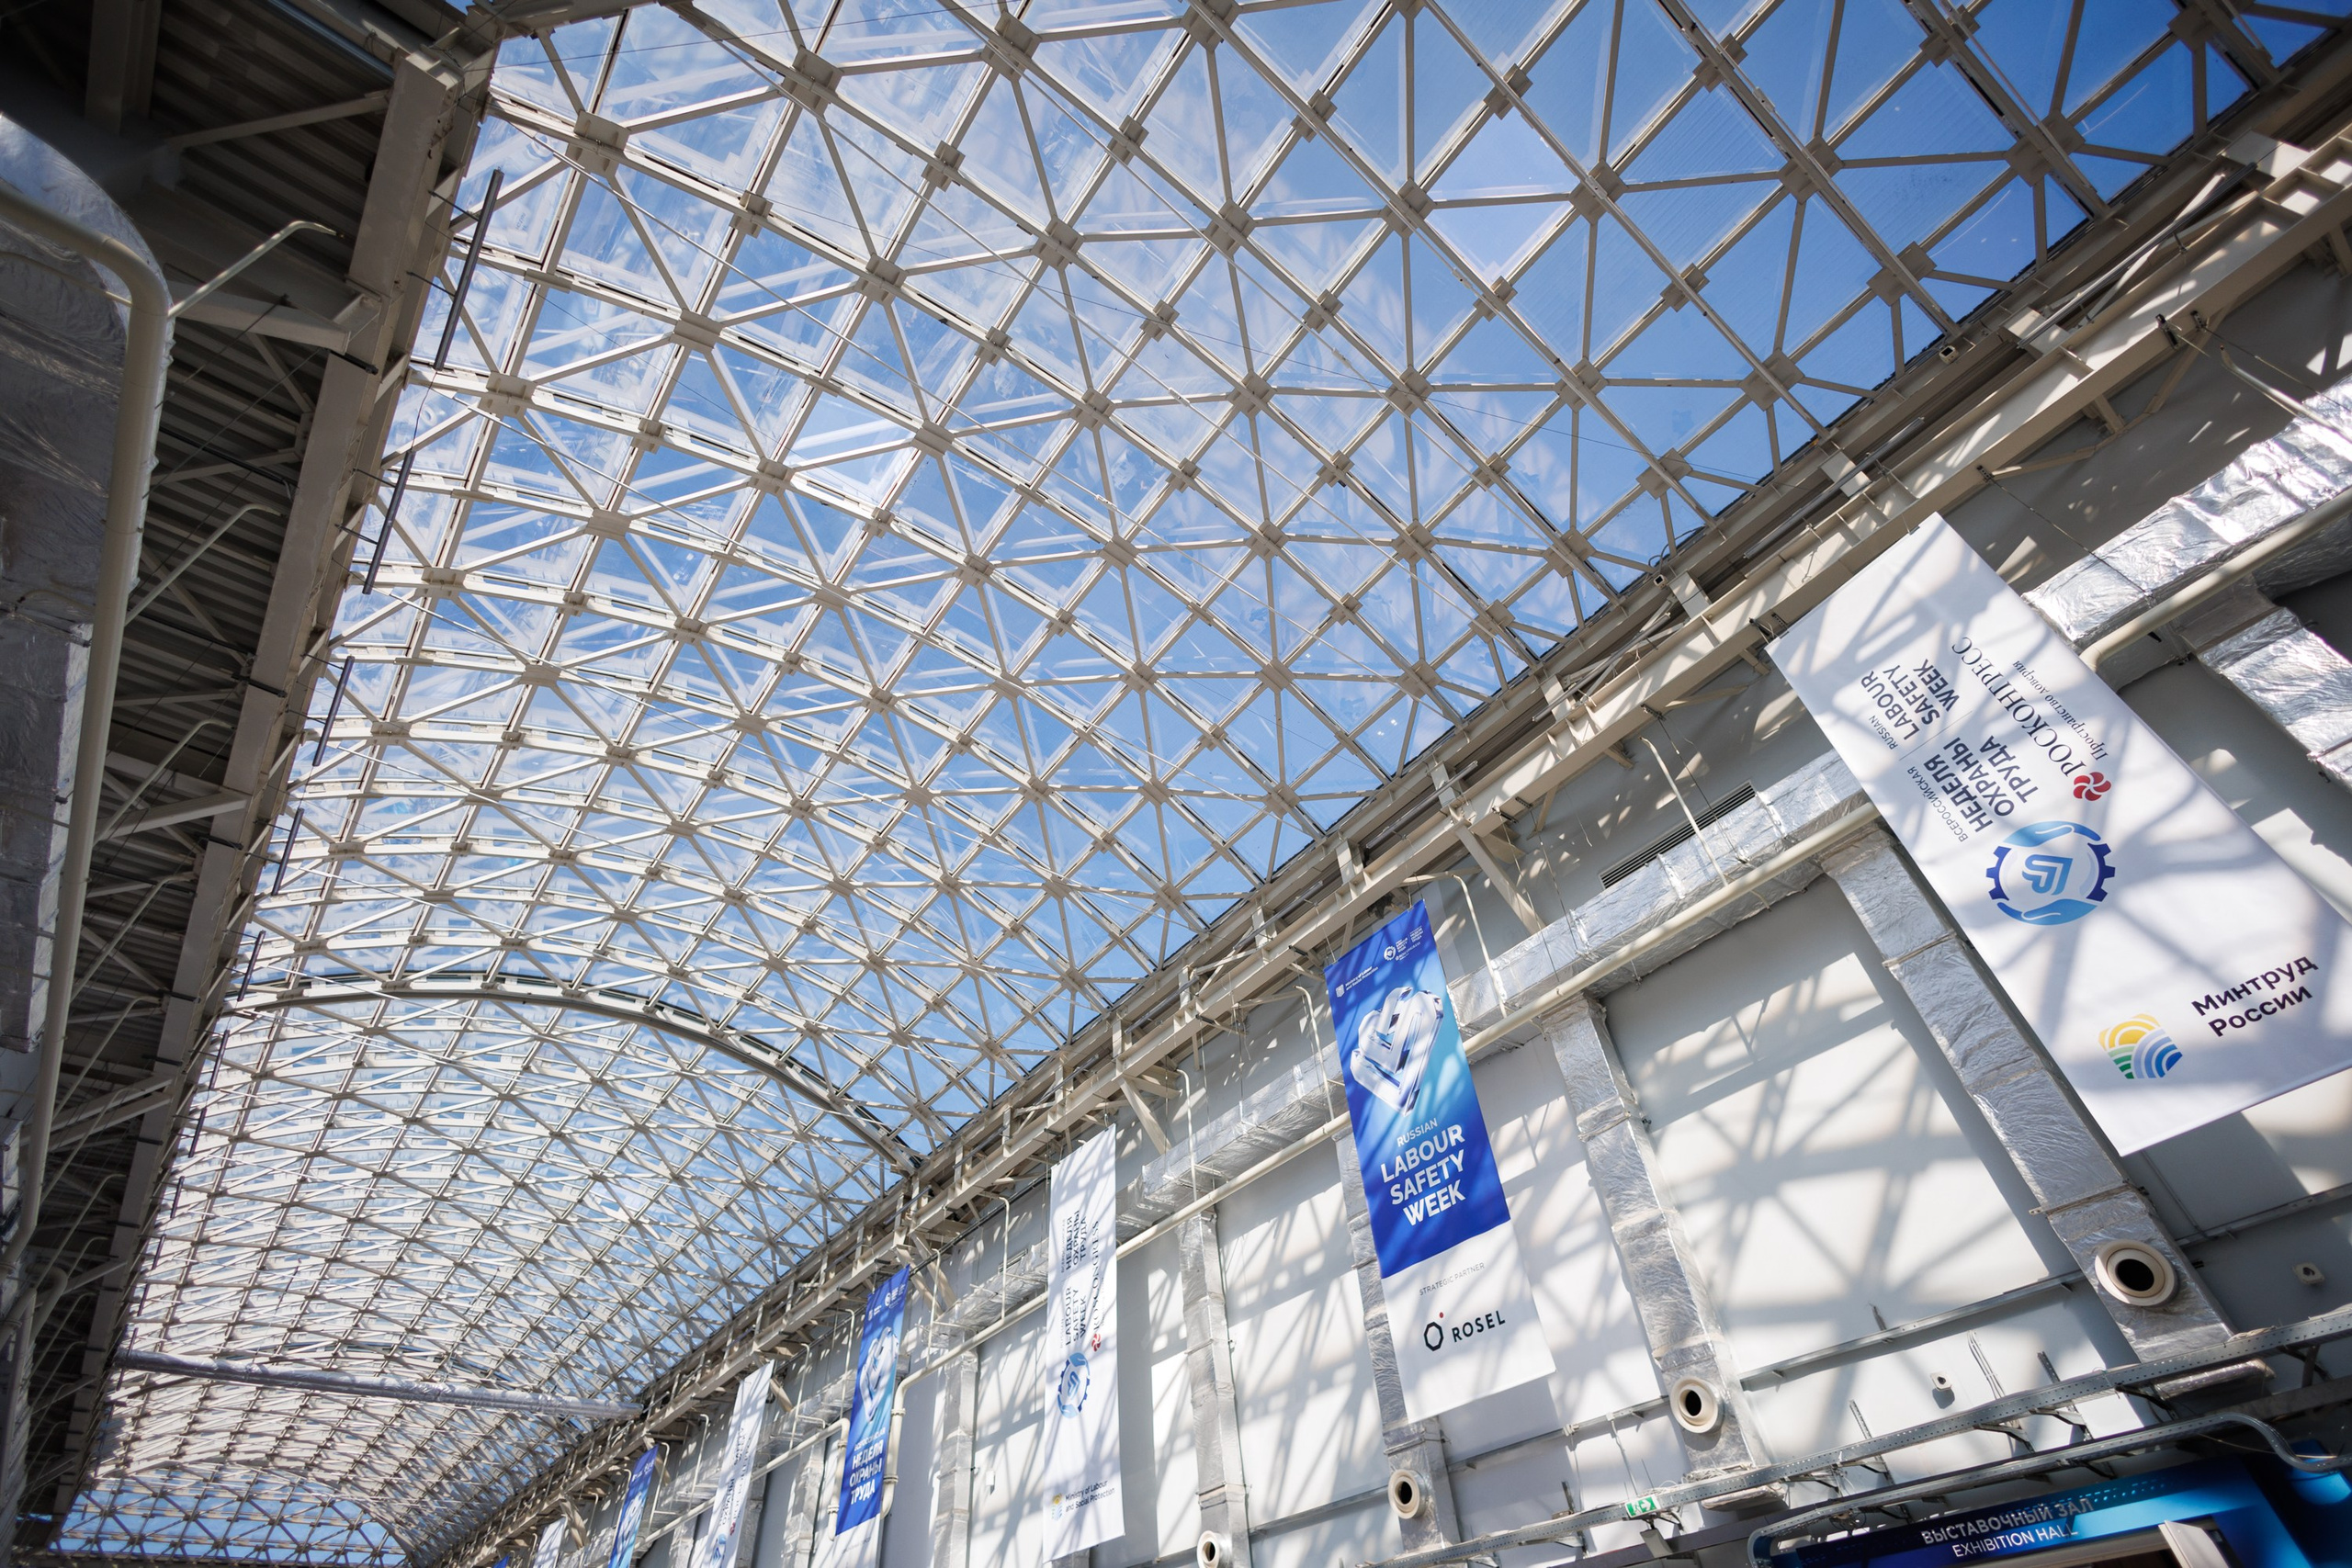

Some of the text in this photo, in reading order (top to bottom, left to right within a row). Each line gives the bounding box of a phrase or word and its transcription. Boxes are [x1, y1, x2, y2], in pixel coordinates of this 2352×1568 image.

[1860, 671, 1919, 740] LABOUR
[1883, 664, 1940, 725] SAFETY
[1913, 658, 1960, 712] WEEK
[1951, 637, 2086, 777] РОСКОНГРЕСС
[2012, 660, 2109, 761] Пространство доверия
[1869, 715, 1898, 750] RUSSIAN
[1923, 753, 1994, 832] НЕДЕЛЯ
[1943, 737, 2015, 817] ОХРАНЫ
[1979, 735, 2039, 804] ТРУДА
[1907, 766, 1968, 842] ВСЕРОССИЙСКАЯ
[2191, 956, 2319, 1016] Минтруд
[2208, 986, 2312, 1037] России
[1380, 1124, 1465, 1183] LABOUR
[1396, 1118, 1438, 1147] RUSSIAN
[1390, 1149, 1464, 1205] SAFETY
[1402, 1179, 1466, 1226] WEEK
[1419, 1262, 1485, 1296] STRATEGIC PARTNER
[1452, 1310, 1506, 1343] ROSEL
[850, 1458, 882, 1487] ОХРАНЫ
[852, 1439, 884, 1470] НЕДЕЛЯ
[851, 1479, 876, 1505] ТРУДА
[1921, 1497, 2094, 1544] ВЫСТАВОЧНЫЙ ЗАЛ
[1951, 1524, 2078, 1558] EXHIBITION HALL
